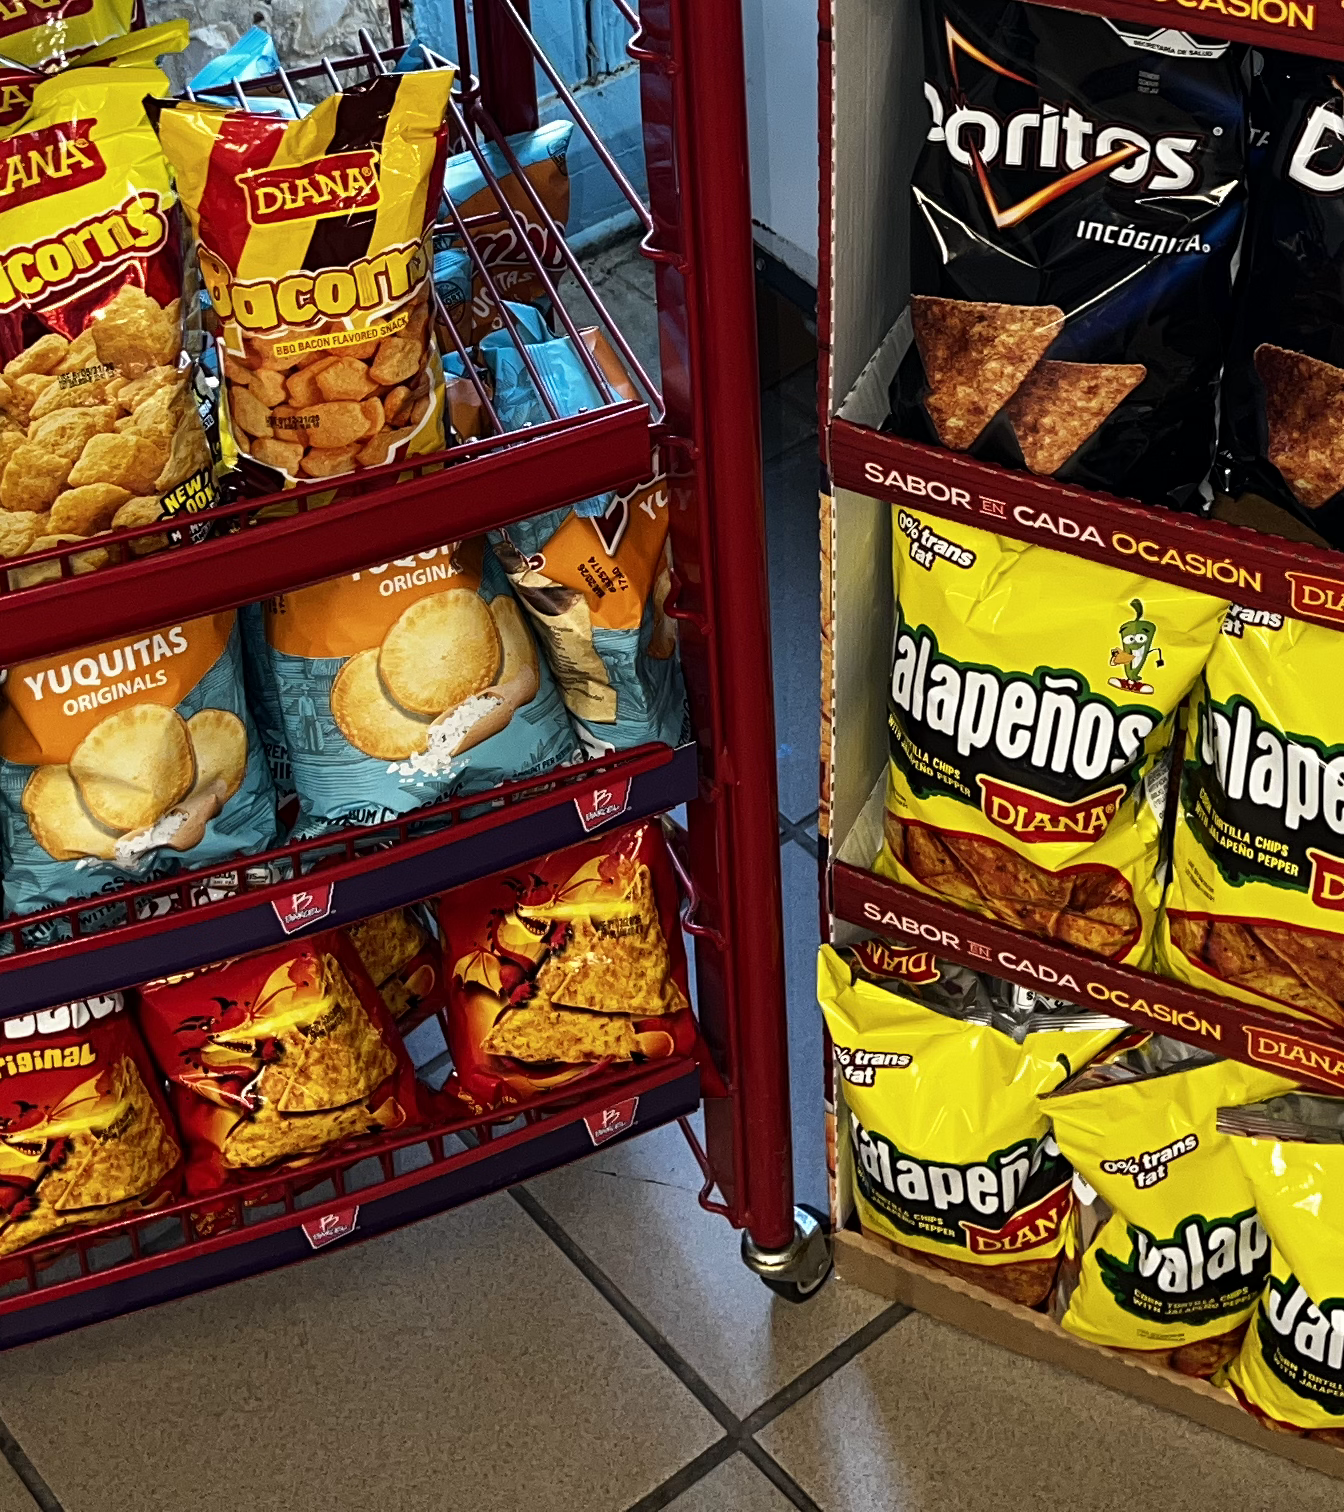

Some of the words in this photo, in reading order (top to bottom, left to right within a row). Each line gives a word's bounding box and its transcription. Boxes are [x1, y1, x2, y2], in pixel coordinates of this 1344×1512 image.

[253, 168, 371, 215] DIANA
[274, 343, 297, 357] BBQ
[298, 337, 327, 354] BACON
[328, 328, 378, 349] FLAVORED
[379, 316, 410, 338] SNACK
[864, 462, 972, 510] SABOR
[982, 498, 1006, 517] EN
[1013, 505, 1107, 548] CADA
[1112, 531, 1263, 593] OCASIÓN
[899, 512, 920, 540] 0%
[919, 529, 975, 568] trans
[910, 542, 935, 570] fat
[23, 624, 189, 703] YUQUITAS
[61, 669, 168, 717] ORIGINALS
[991, 799, 1109, 837] DIANA
[1254, 836, 1289, 856] CHIPS
[1256, 853, 1299, 877] PEPPER
[863, 901, 961, 951] SABOR
[969, 943, 992, 959] EN
[998, 951, 1081, 994] CADA
[1087, 981, 1224, 1042] OCASIÓN
[844, 1065, 875, 1085] fat
[1103, 1158, 1140, 1175] 0%
[1142, 1135, 1198, 1169] trans
[1136, 1164, 1166, 1188] fat
